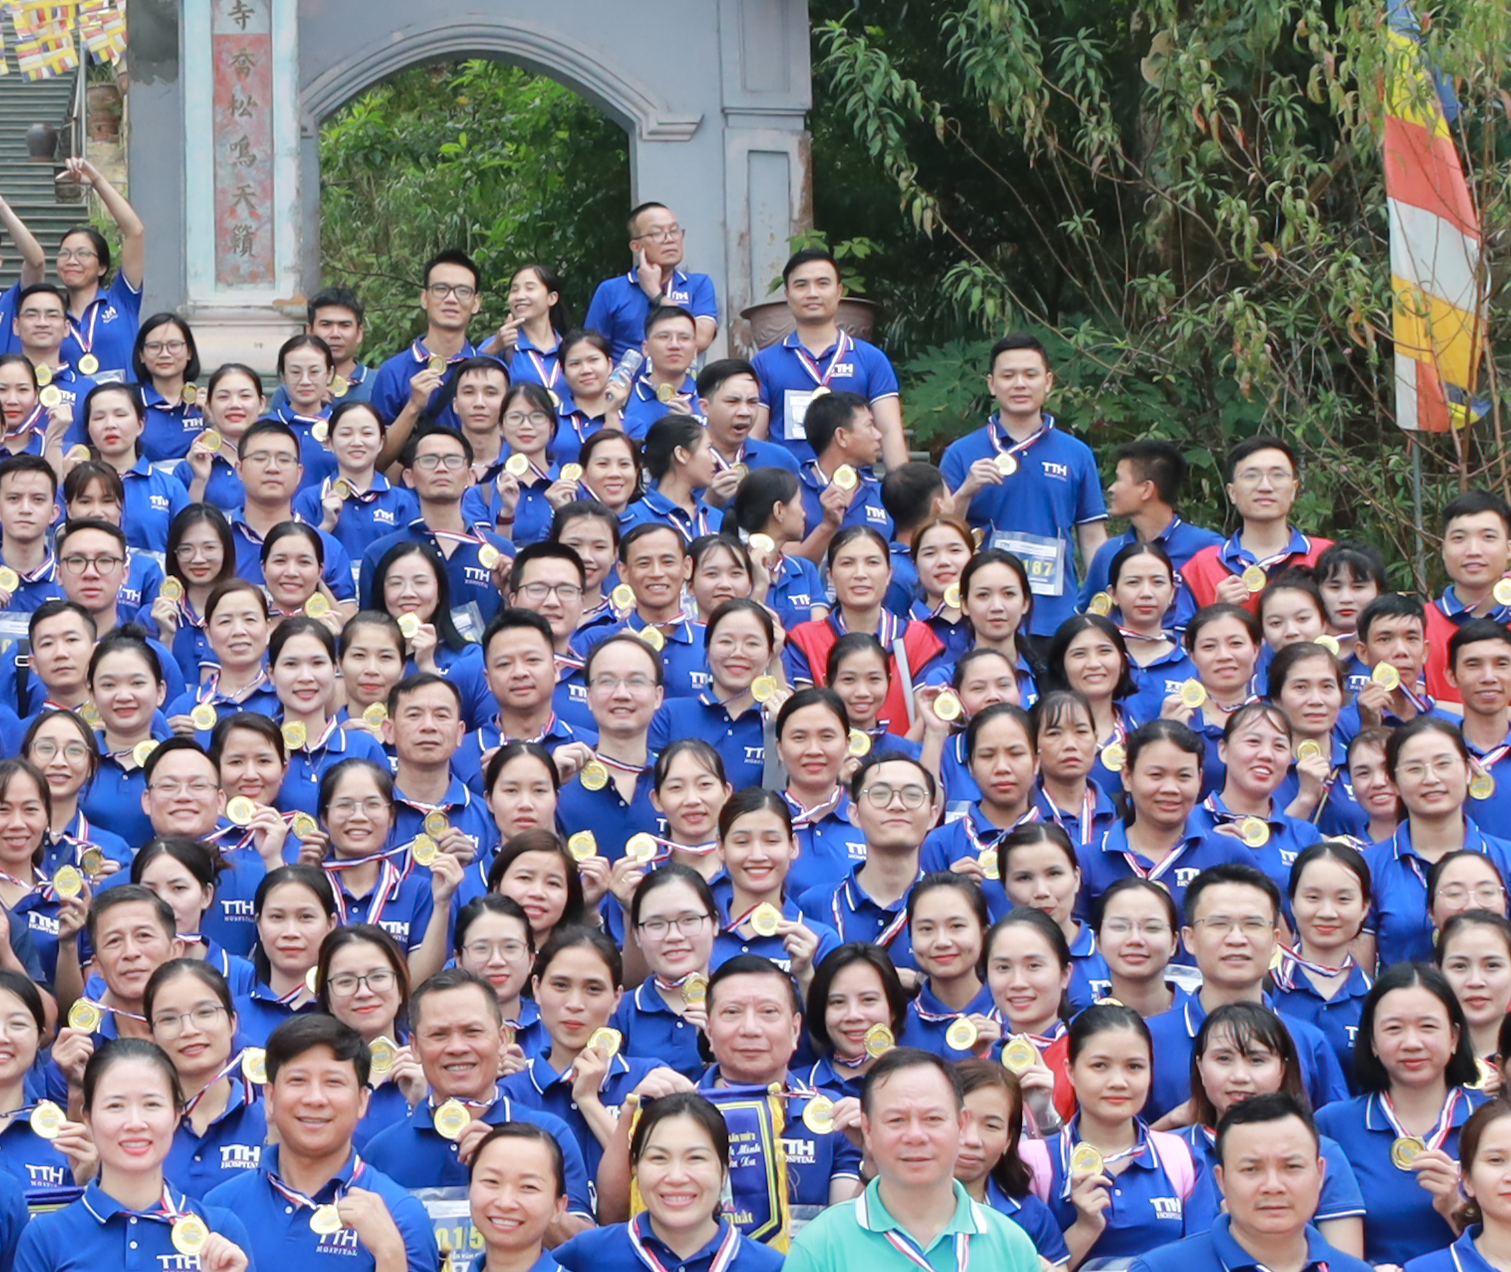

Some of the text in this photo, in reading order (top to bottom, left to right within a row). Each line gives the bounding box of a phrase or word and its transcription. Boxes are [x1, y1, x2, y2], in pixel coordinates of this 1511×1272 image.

[1042, 462, 1067, 476] TTH
[373, 509, 394, 521] TTH
[865, 505, 887, 520] TTH
[464, 567, 490, 581] TTH
[221, 900, 254, 915] TTH
[27, 910, 59, 928] TTH
[220, 1144, 260, 1161] TTH
[25, 1164, 64, 1184] TTH
[1150, 1197, 1182, 1212] TTH
[435, 1226, 486, 1251] 015
[316, 1246, 358, 1256] HOSPITAL
[156, 1255, 201, 1269] TTH
